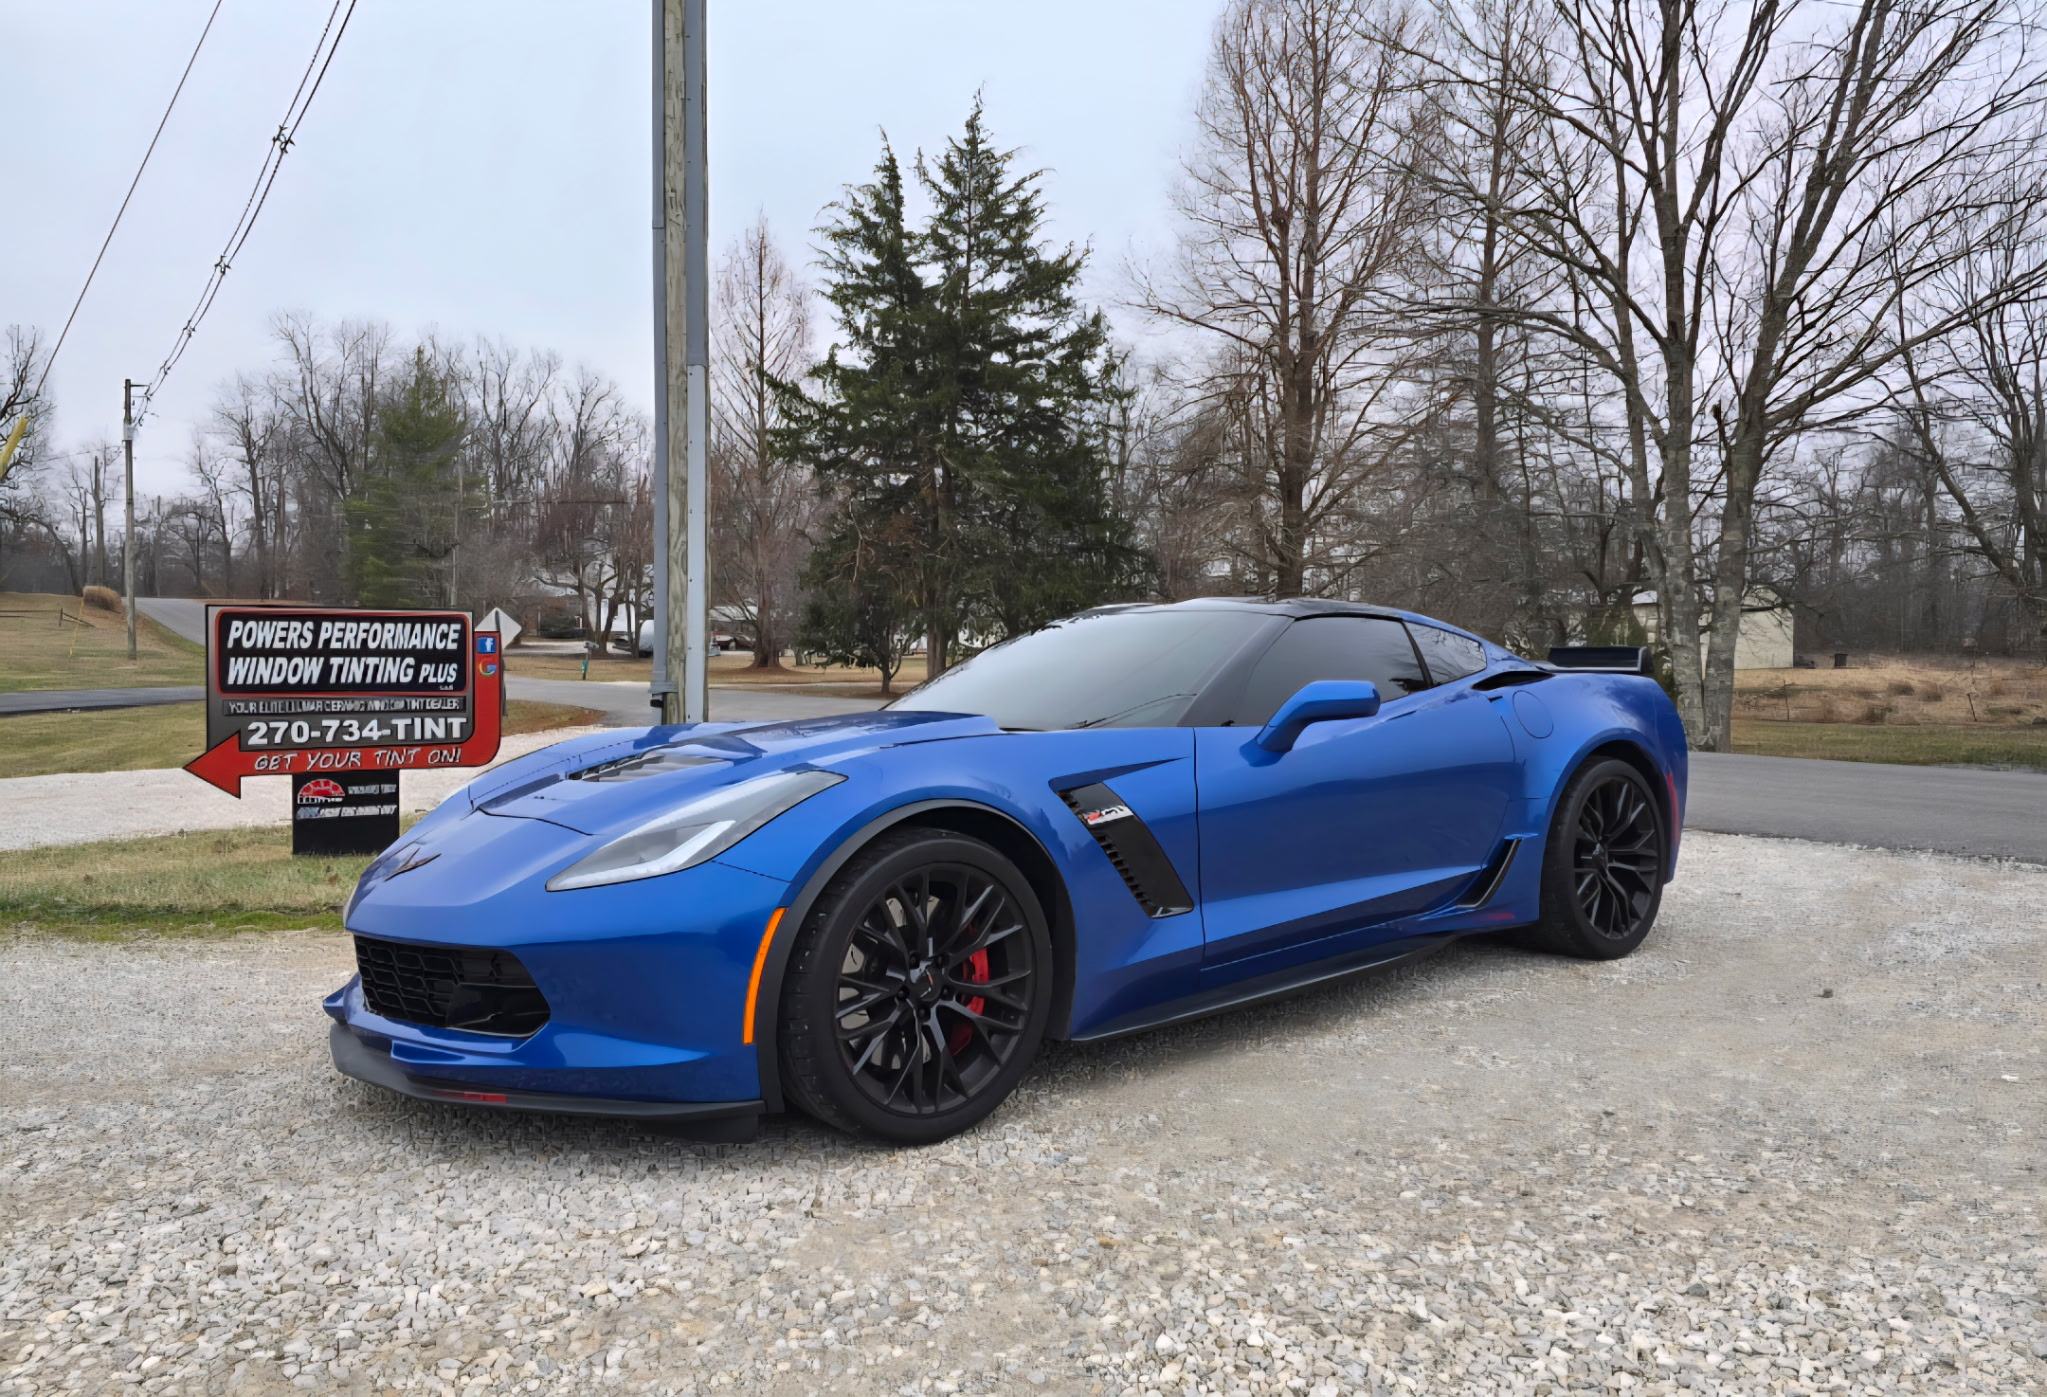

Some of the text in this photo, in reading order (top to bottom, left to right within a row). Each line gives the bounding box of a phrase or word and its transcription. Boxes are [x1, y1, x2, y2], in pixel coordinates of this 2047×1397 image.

[227, 620, 462, 650] POWERS PERFORMANCE
[227, 656, 458, 686] WINDOW TINTING PLUS
[247, 717, 467, 745] 270-734-TINT
[254, 748, 462, 771] GET YOUR TINT ON!
